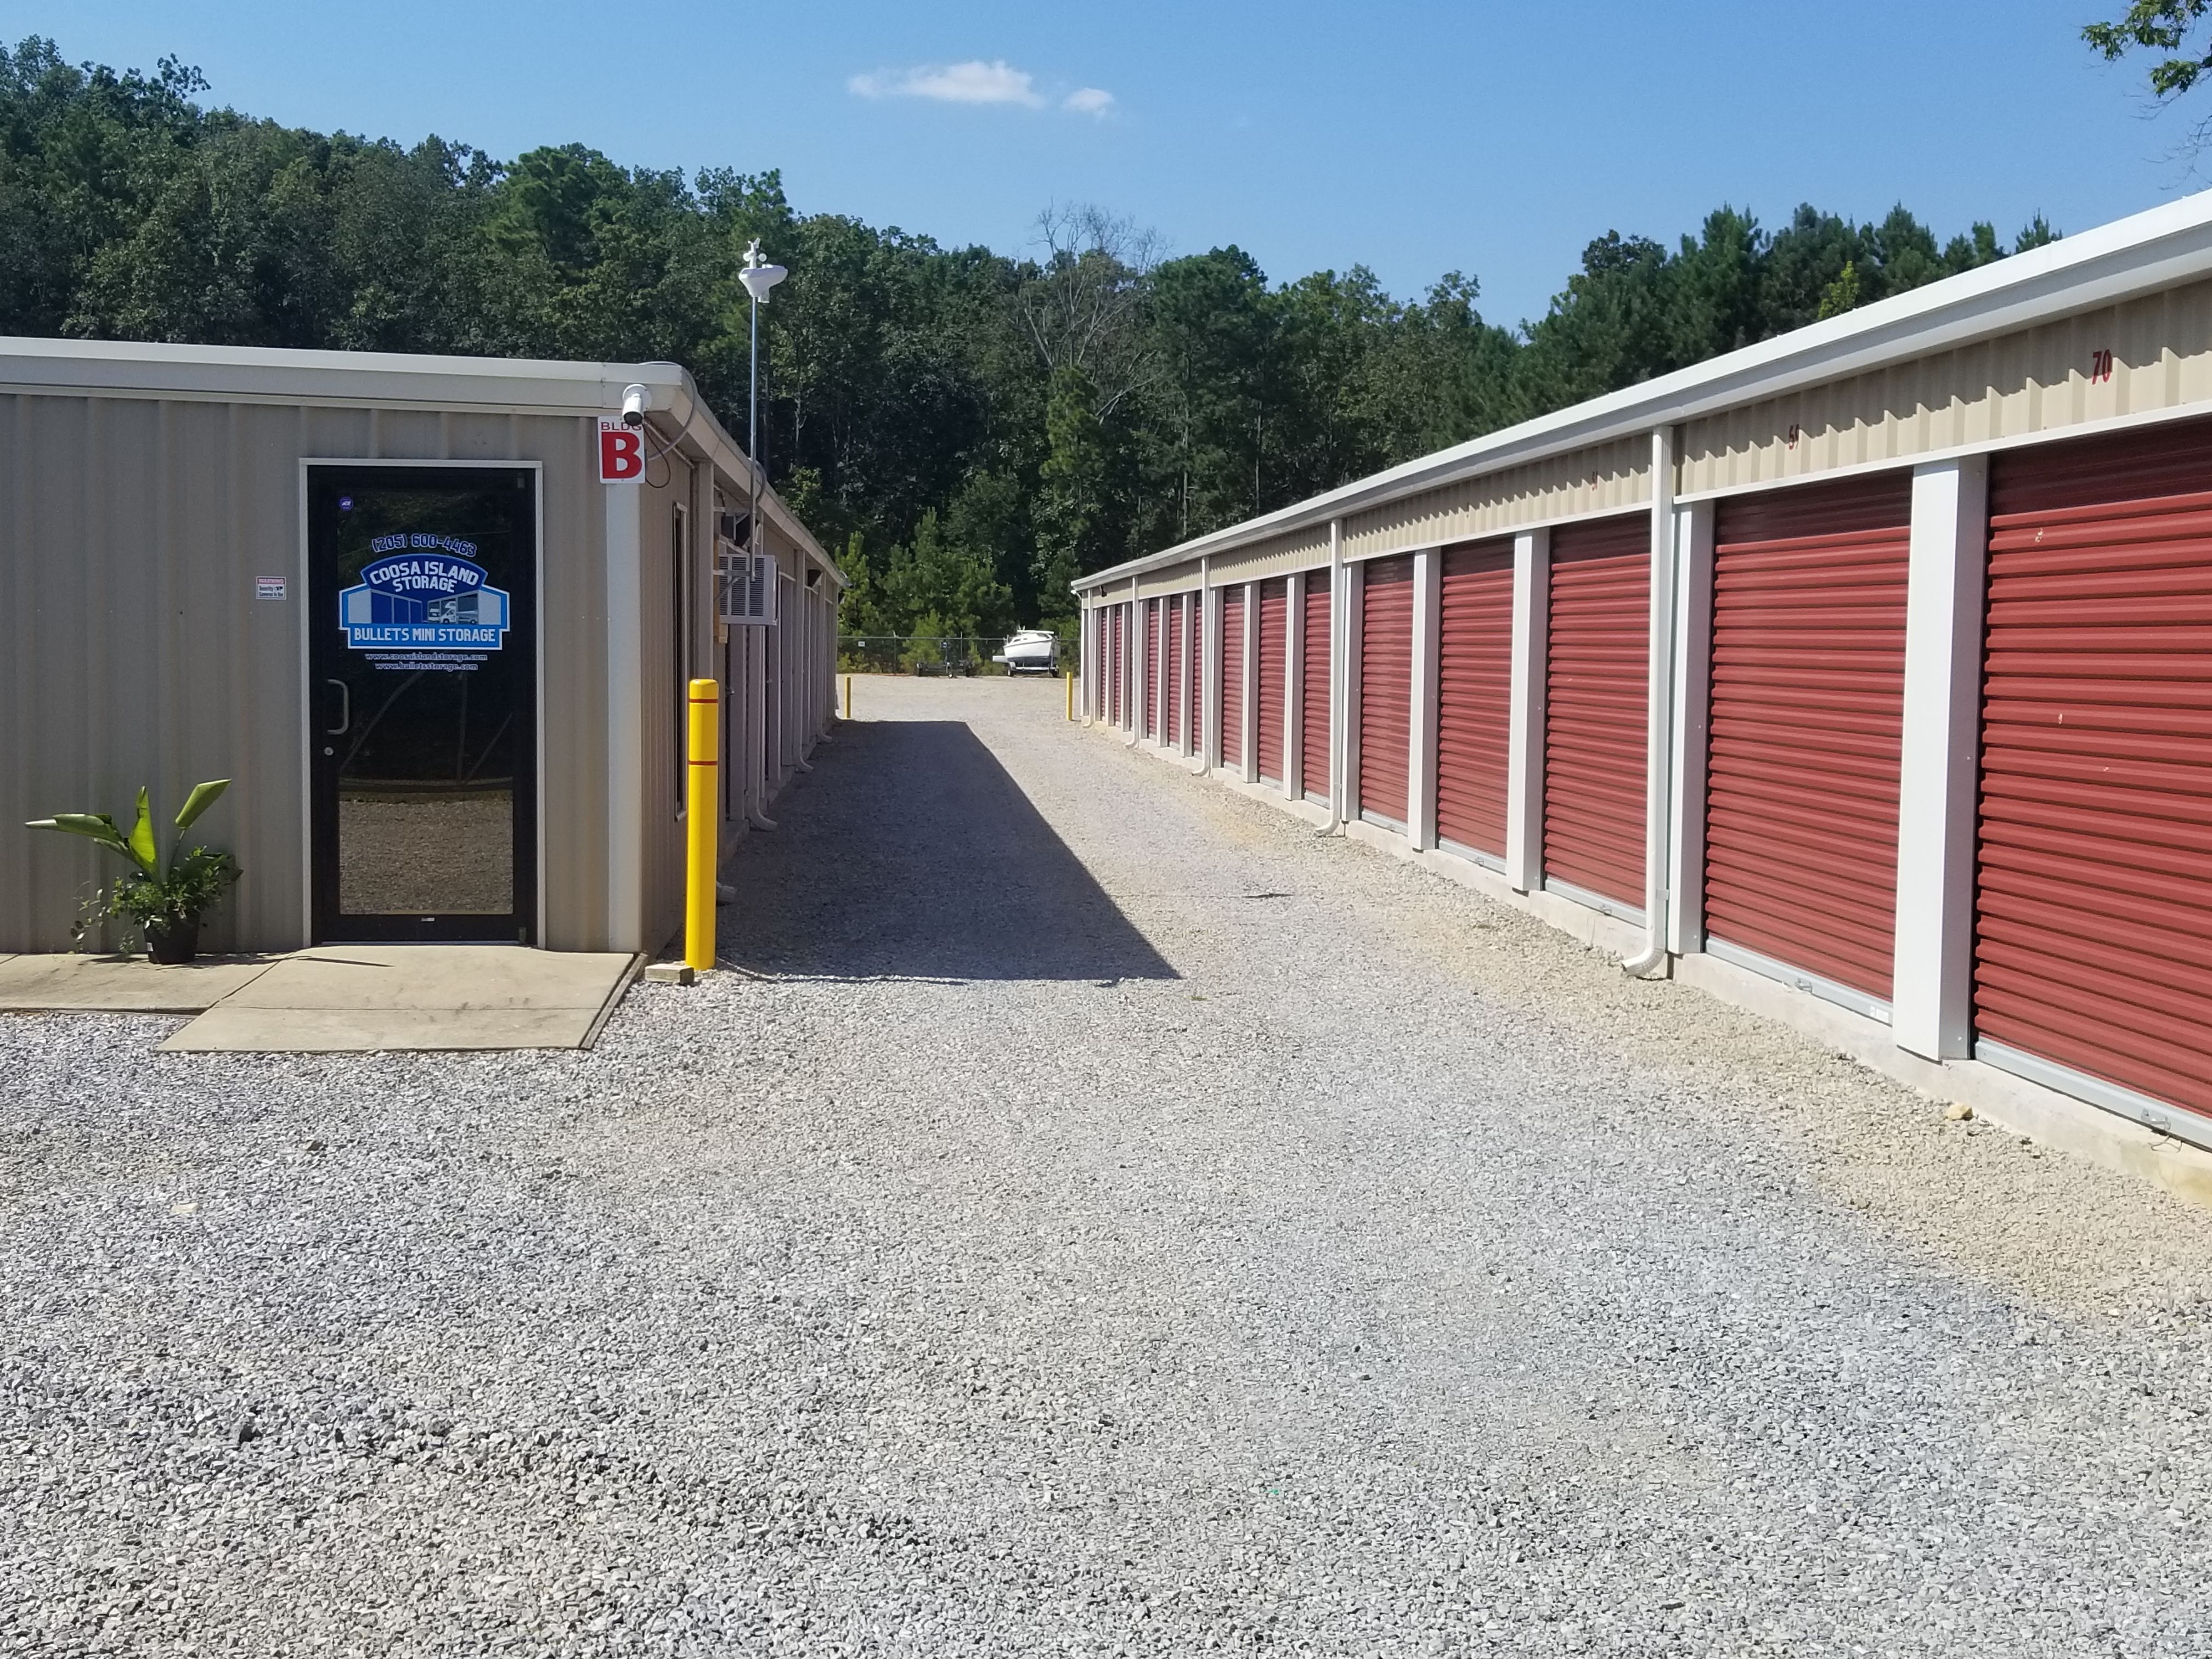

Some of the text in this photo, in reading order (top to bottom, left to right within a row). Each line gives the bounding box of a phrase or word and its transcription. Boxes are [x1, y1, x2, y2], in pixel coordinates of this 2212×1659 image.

[2092, 349, 2113, 385] 70
[601, 422, 641, 431] BLDG
[601, 431, 642, 479] B
[372, 533, 477, 557] (205) 600-4463
[369, 561, 479, 586] COOSA ISLAND
[392, 575, 457, 593] STORAGE
[354, 628, 495, 642] BULLETS MINI STORAGE
[365, 652, 488, 663] www.coosaislandstorage.com
